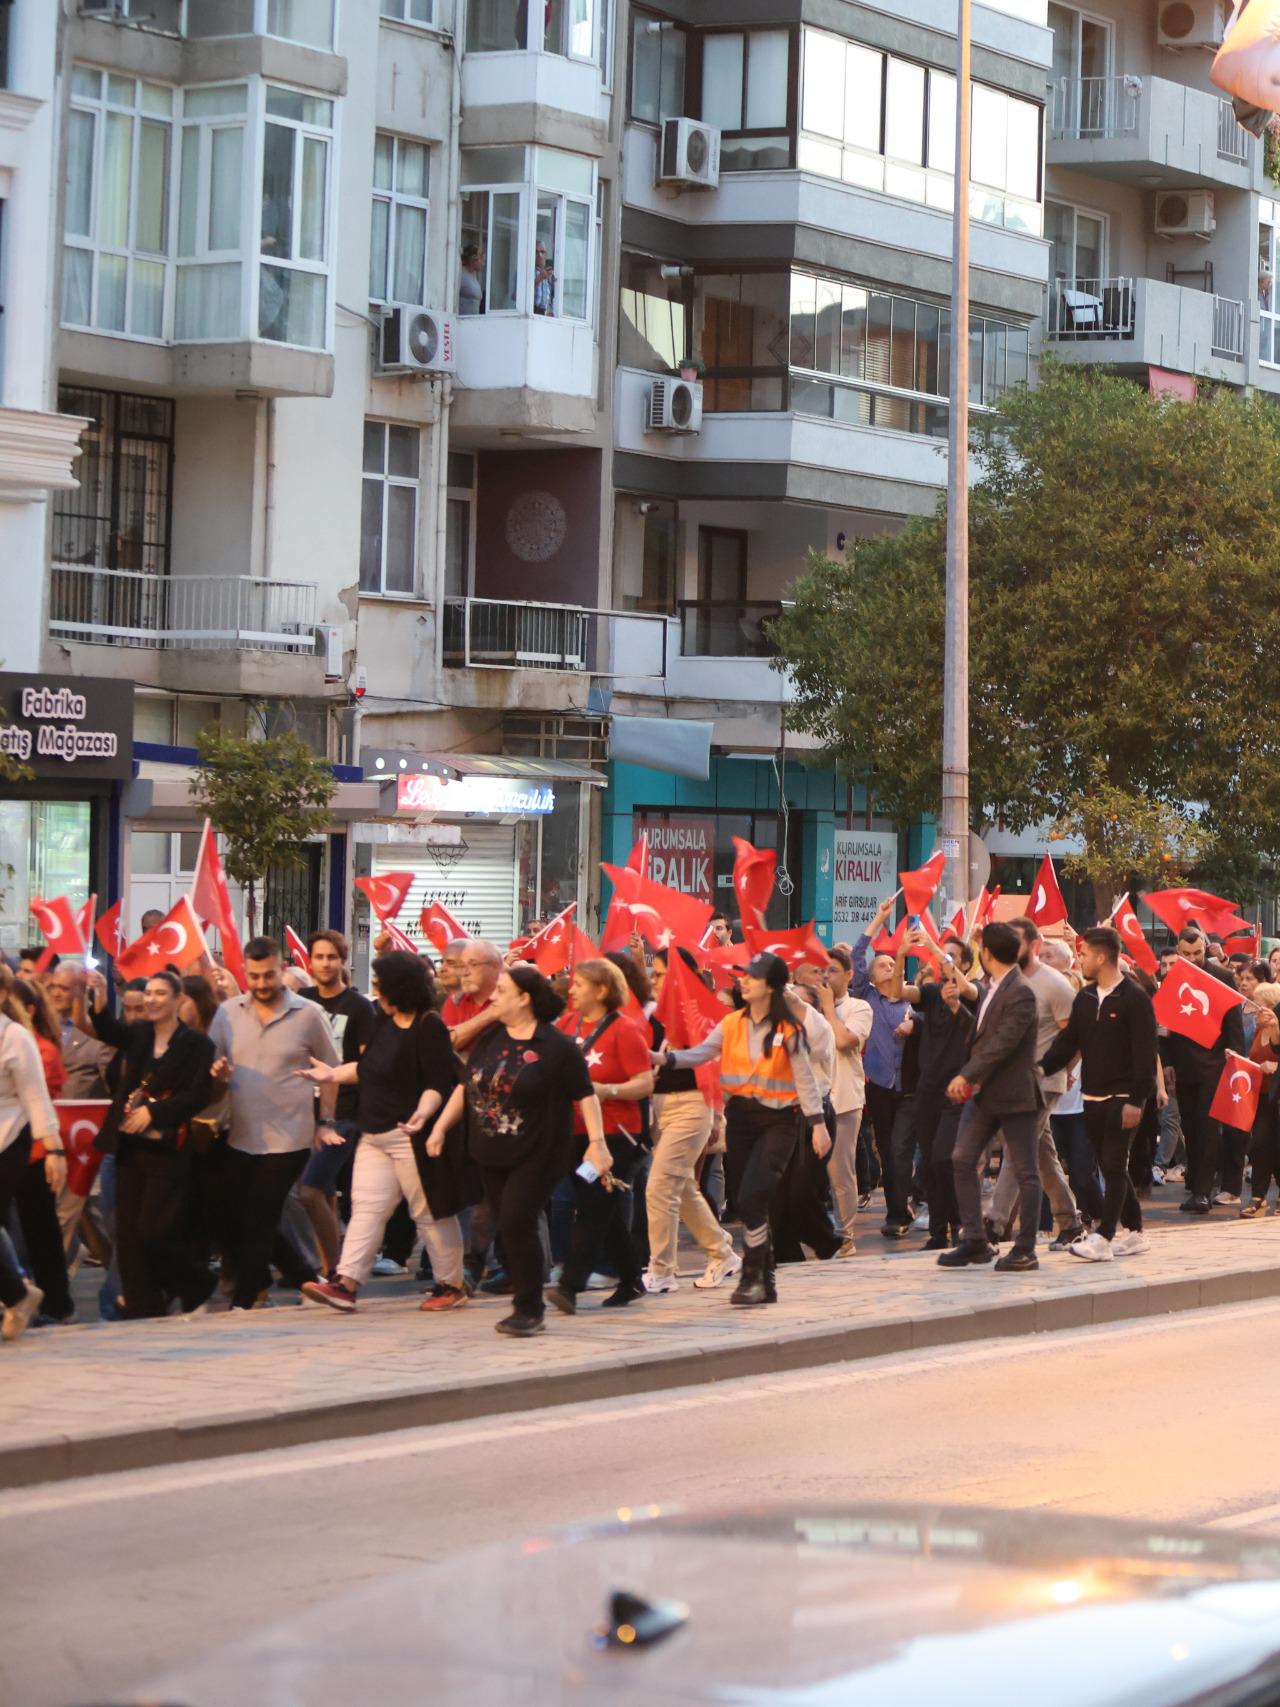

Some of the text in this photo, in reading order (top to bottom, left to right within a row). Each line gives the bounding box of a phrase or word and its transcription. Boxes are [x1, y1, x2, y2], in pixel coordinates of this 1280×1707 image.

[24, 689, 84, 717] Fabrika
[0, 727, 115, 759] atış Mağazası
[836, 841, 882, 857] KURUMSALA
[647, 854, 710, 893] İRALIK
